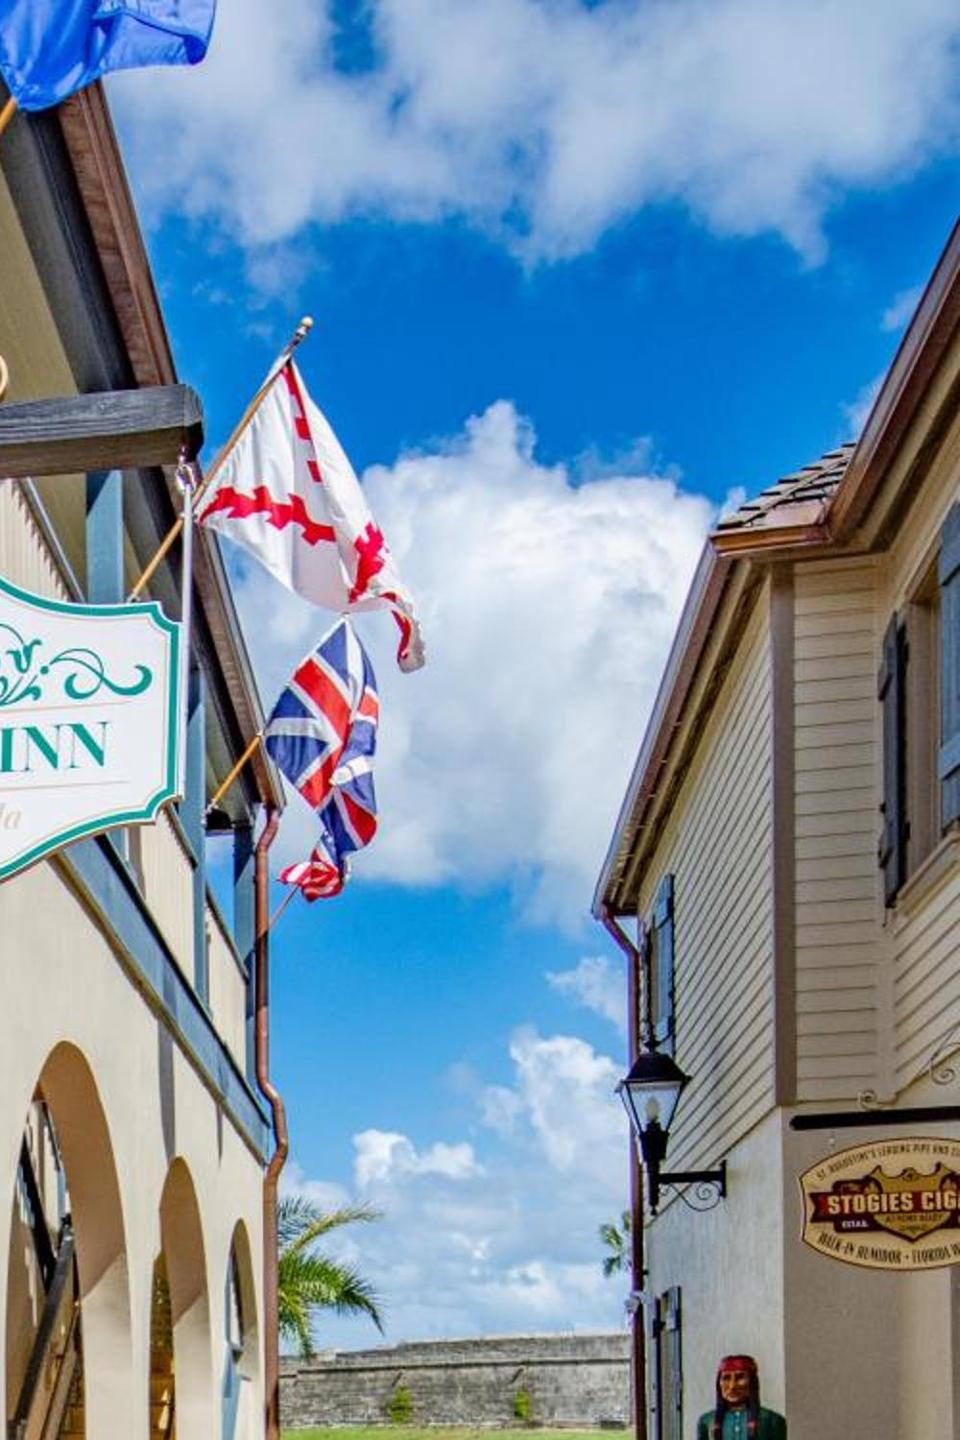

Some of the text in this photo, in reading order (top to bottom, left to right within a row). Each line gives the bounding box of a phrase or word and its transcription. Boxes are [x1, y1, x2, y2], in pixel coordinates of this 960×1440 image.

[0, 721, 111, 774] INN
[827, 1190, 960, 1214] STOGIES CIG
